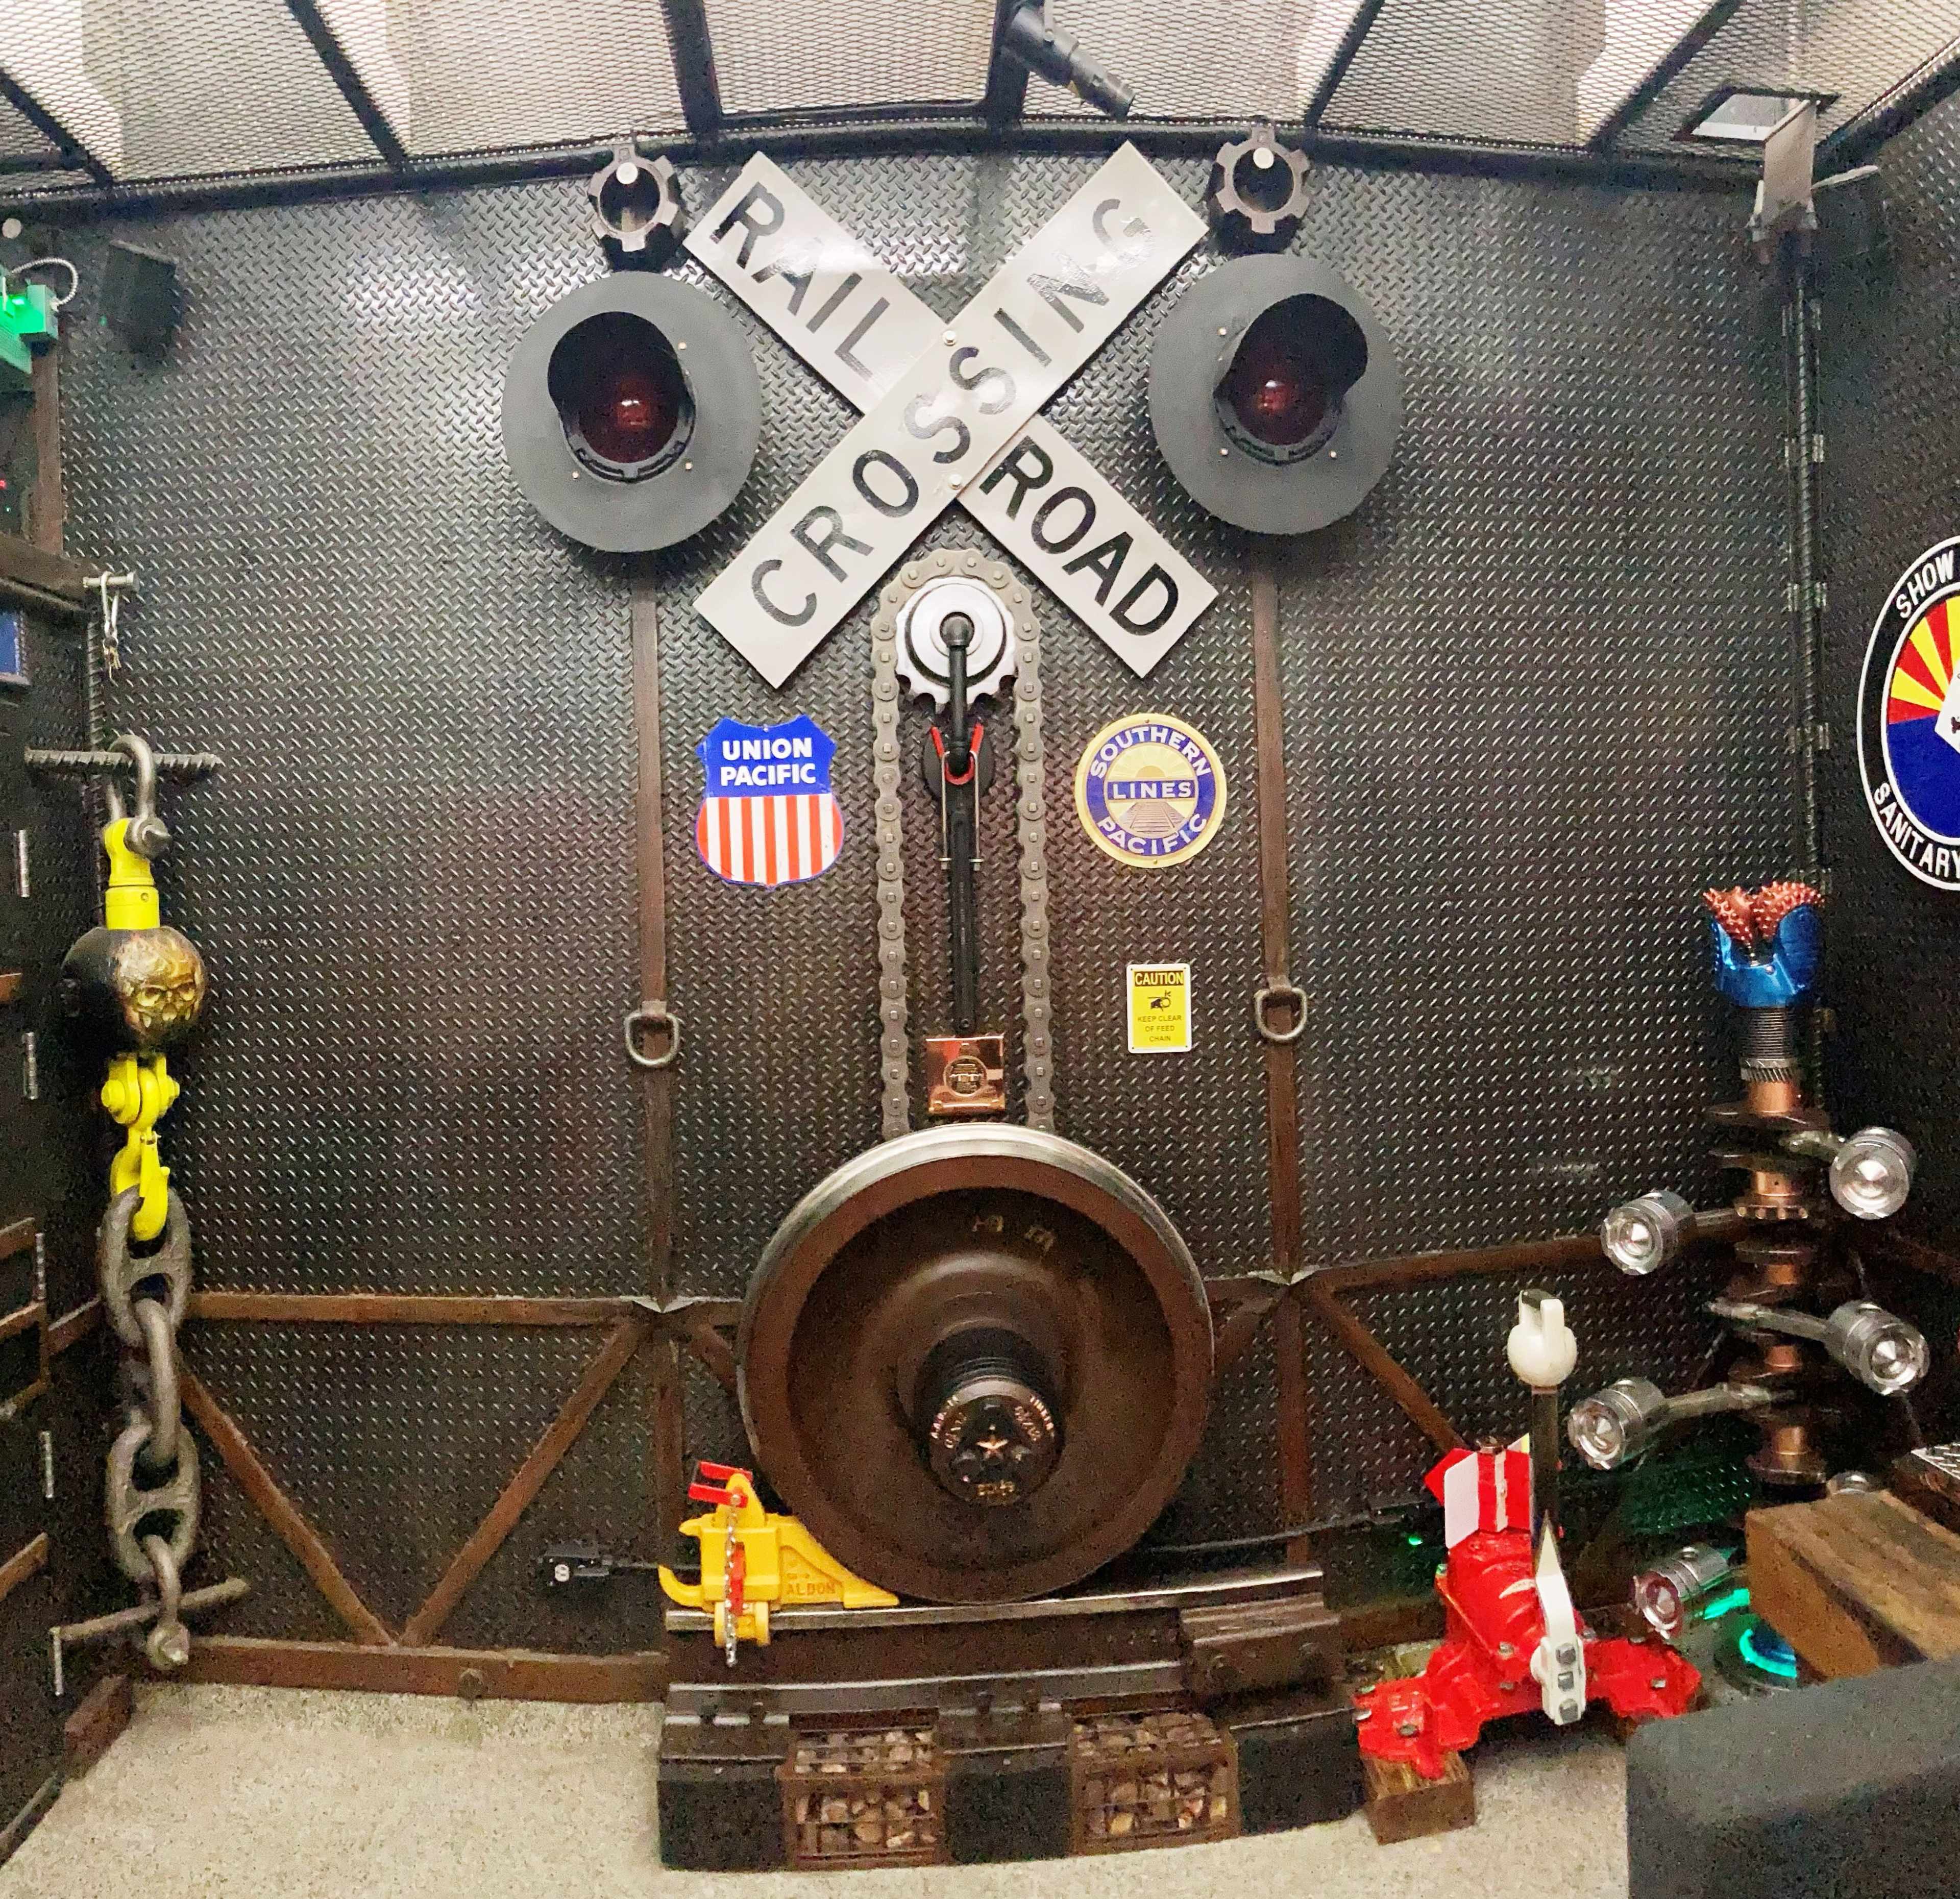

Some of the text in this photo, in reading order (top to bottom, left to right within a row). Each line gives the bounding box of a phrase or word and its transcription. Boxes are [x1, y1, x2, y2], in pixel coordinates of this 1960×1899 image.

[710, 181, 1179, 636] RAIL ROAD
[750, 198, 1156, 627] CROSSING
[1896, 550, 1954, 619] SHOW
[722, 737, 813, 761] UNION
[1090, 726, 1211, 779] SOUTHERN
[720, 762, 817, 786] PACIFIC
[1112, 781, 1192, 800] LINES
[1098, 813, 1207, 855] PACIFIC
[1874, 782, 1960, 879] SANITARY
[1135, 972, 1184, 985] CAUTION
[787, 1583, 836, 1595] ALDON
